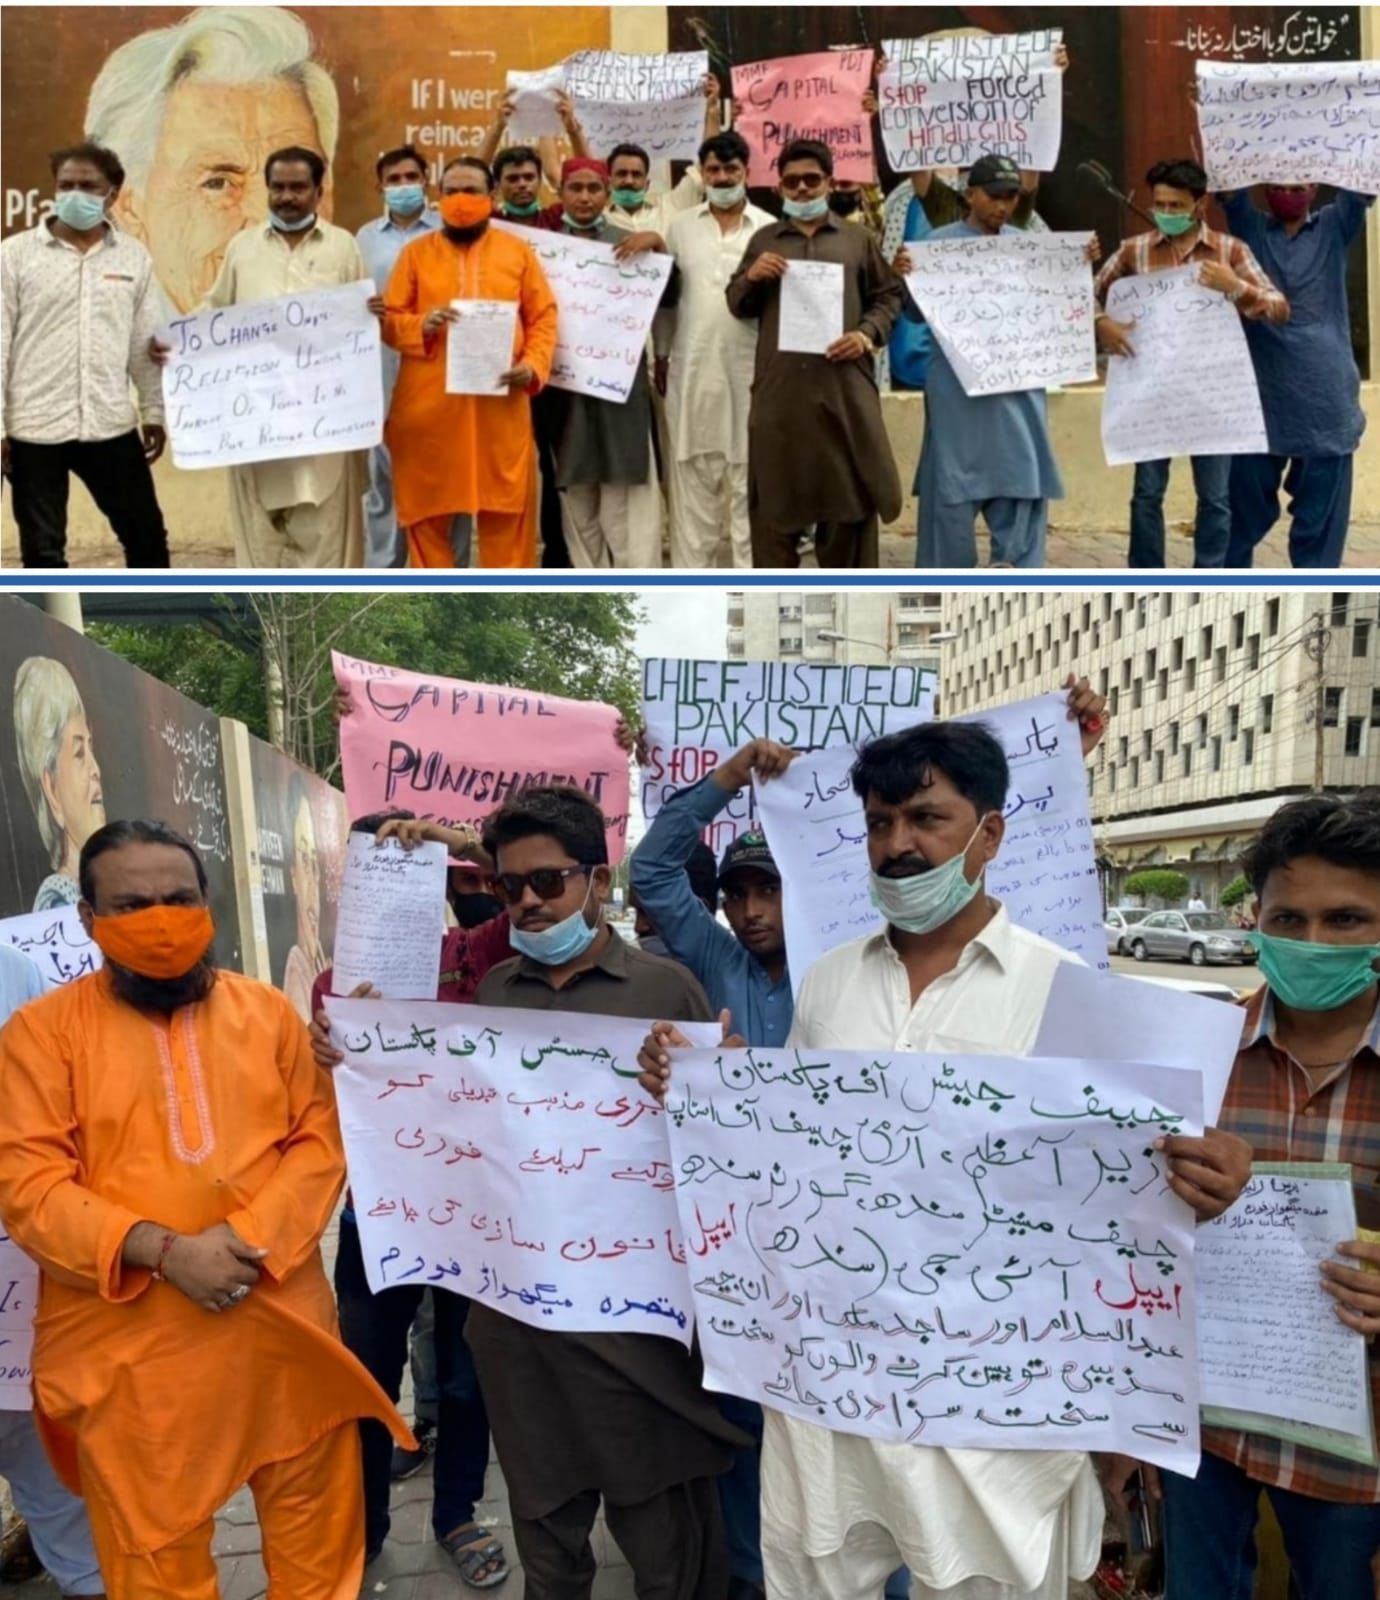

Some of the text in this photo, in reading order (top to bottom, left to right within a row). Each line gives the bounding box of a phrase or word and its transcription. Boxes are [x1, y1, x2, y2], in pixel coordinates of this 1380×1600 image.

[899, 52, 1030, 84] PAKISTAN
[412, 78, 433, 110] If
[450, 88, 500, 110] wer
[749, 77, 839, 112] CAPITAL
[366, 677, 556, 722] CAPITAL
[643, 658, 938, 707] CHIEF JUSTICE OF
[674, 700, 890, 749] PAKISTAN
[714, 1048, 831, 1105] پاکستان
[834, 1060, 893, 1098] آف
[394, 1127, 483, 1166] فوری
[769, 1111, 853, 1160] چیف
